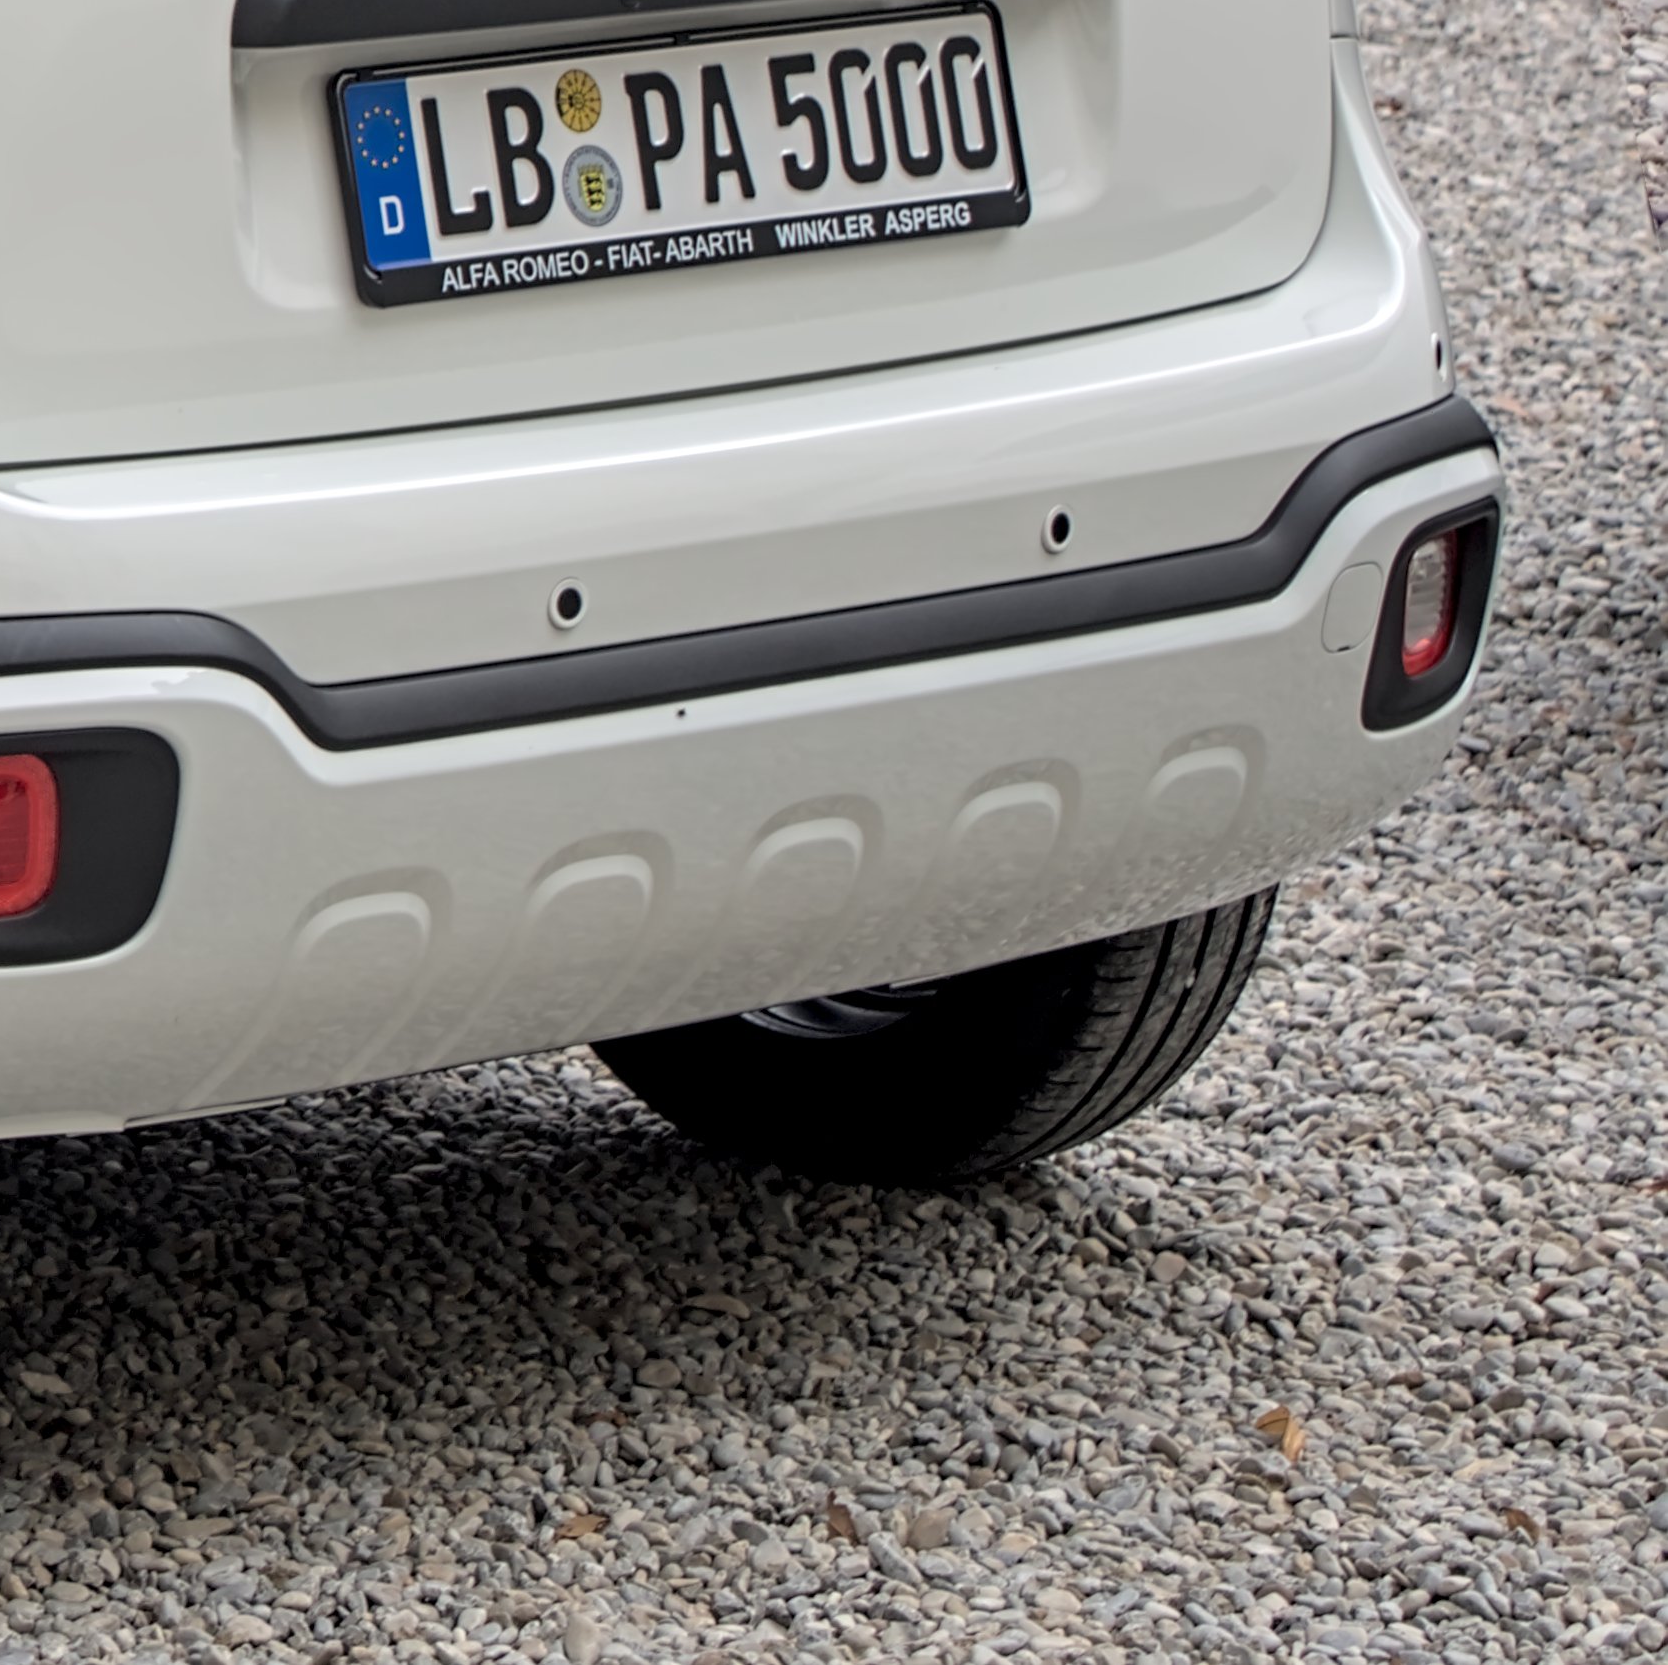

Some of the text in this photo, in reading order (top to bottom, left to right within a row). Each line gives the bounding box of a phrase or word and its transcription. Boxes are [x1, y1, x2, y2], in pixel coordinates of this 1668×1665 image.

[419, 87, 555, 237] LB
[623, 64, 757, 211] PA
[767, 35, 998, 191] 5000
[379, 194, 406, 236] D
[441, 259, 501, 293] ALFA
[502, 248, 589, 285] ROMEO
[665, 228, 755, 264] ABARTH
[774, 213, 877, 249] WINKLER
[884, 200, 972, 236] ASPERG
